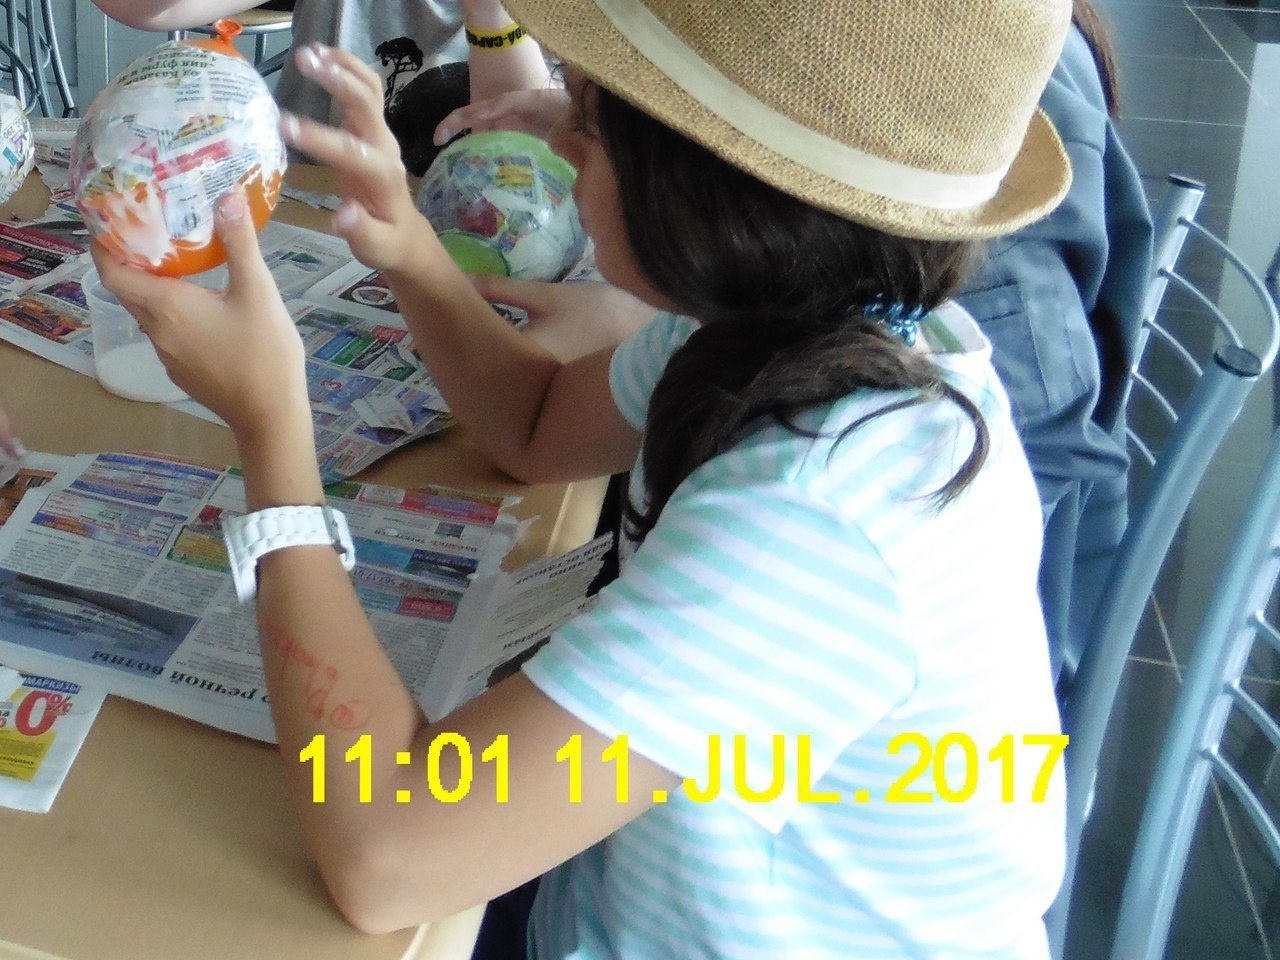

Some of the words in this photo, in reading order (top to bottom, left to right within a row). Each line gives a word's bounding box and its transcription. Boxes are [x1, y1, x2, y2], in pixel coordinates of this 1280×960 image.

[90, 650, 166, 677] волны
[24, 676, 81, 694] МАРКИЗЫ
[169, 670, 257, 701] речной
